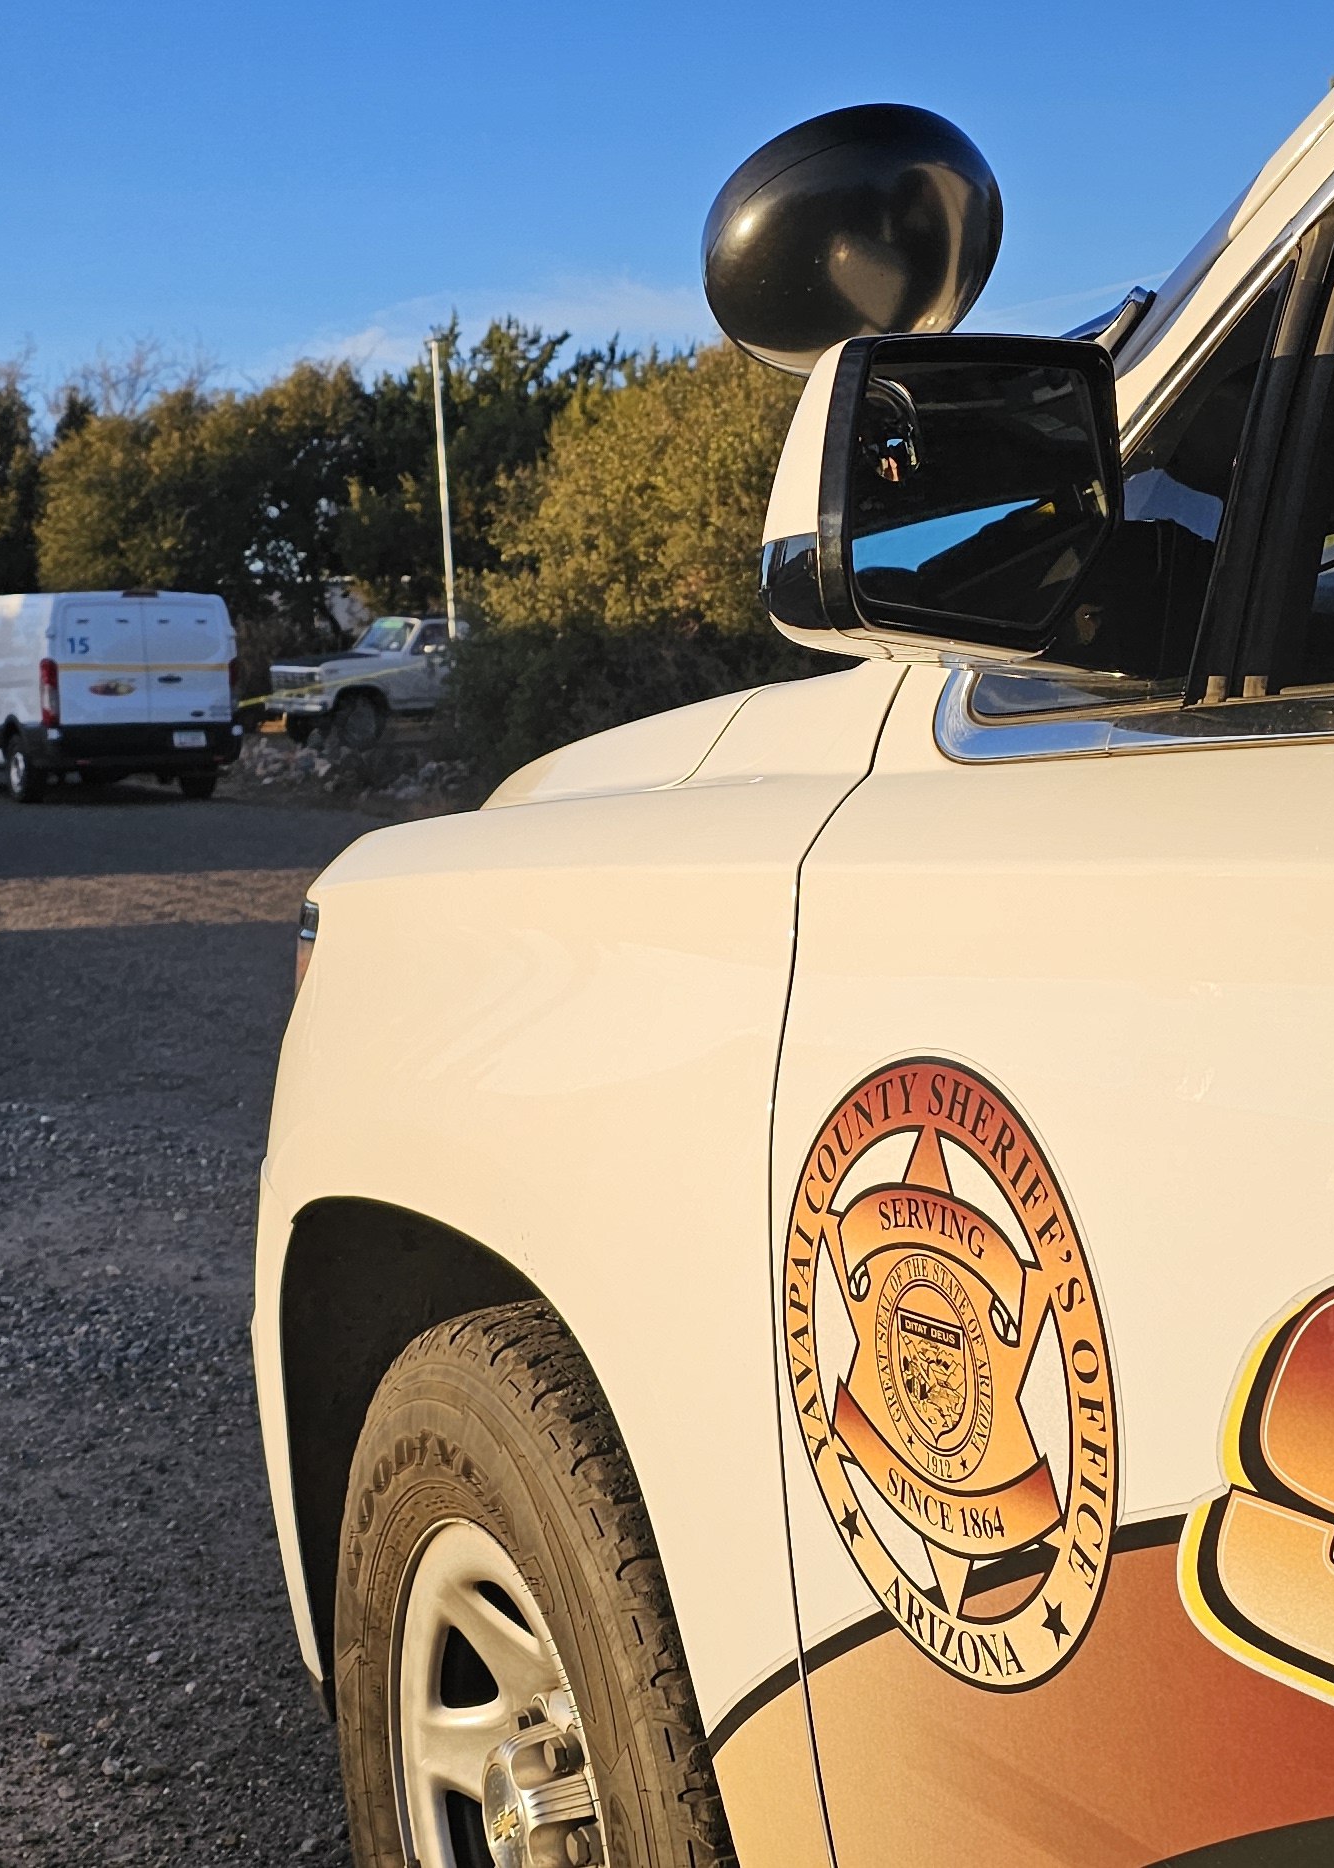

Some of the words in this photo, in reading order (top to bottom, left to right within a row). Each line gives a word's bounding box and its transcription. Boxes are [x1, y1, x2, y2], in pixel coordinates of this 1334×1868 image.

[67, 636, 90, 655] 15
[804, 1072, 919, 1215] COUNTY
[927, 1073, 1087, 1314] SHERIFF'S
[878, 1197, 986, 1260] SERVING
[889, 1266, 903, 1301] OF
[904, 1257, 929, 1280] THE
[932, 1263, 970, 1316] STATE
[789, 1220, 831, 1464] YAVAPAI
[877, 1292, 894, 1343] SEAL
[904, 1319, 928, 1336] DITAT
[930, 1327, 957, 1345] DEUS
[967, 1317, 984, 1348] OF
[878, 1349, 903, 1424] GREAT
[970, 1356, 992, 1455] ARIZONA
[925, 1451, 953, 1479] 1912
[1067, 1338, 1108, 1591] OFFICE
[886, 1467, 955, 1534] SINCE
[958, 1505, 1005, 1540] 1864
[882, 1575, 1026, 1677] ARIZONA
